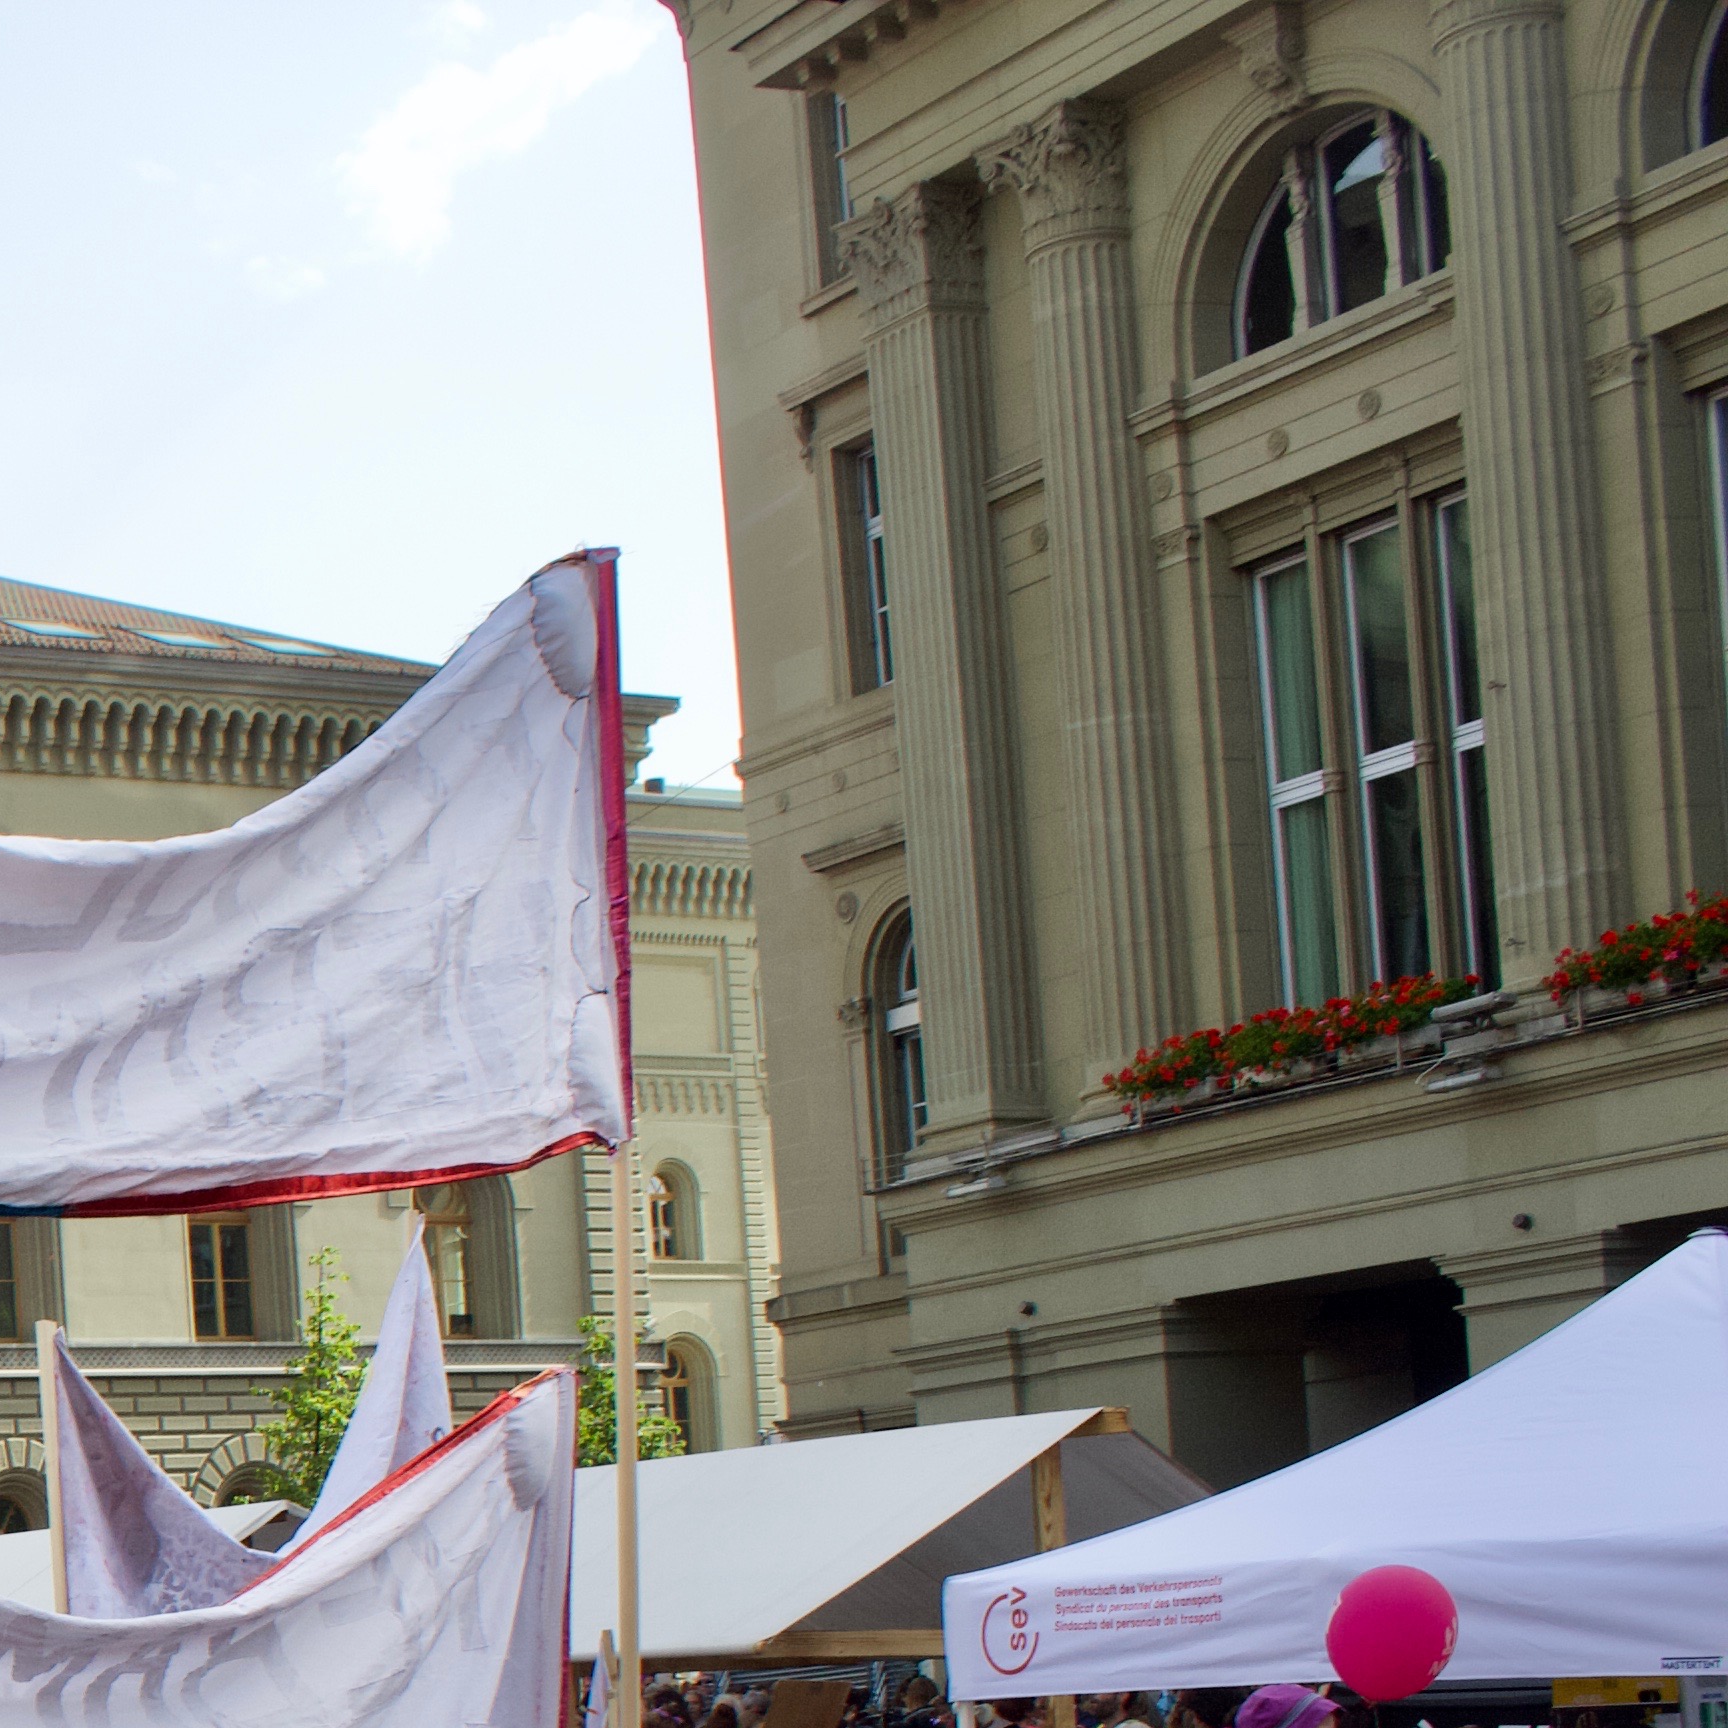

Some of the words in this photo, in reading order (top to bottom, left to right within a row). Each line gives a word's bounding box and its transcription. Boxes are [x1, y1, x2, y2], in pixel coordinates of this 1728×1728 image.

[1055, 1583, 1117, 1598] Gewerkschaft
[1055, 1603, 1094, 1616] Syndicat
[1173, 1593, 1223, 1607] transports
[1010, 1587, 1029, 1651] sev
